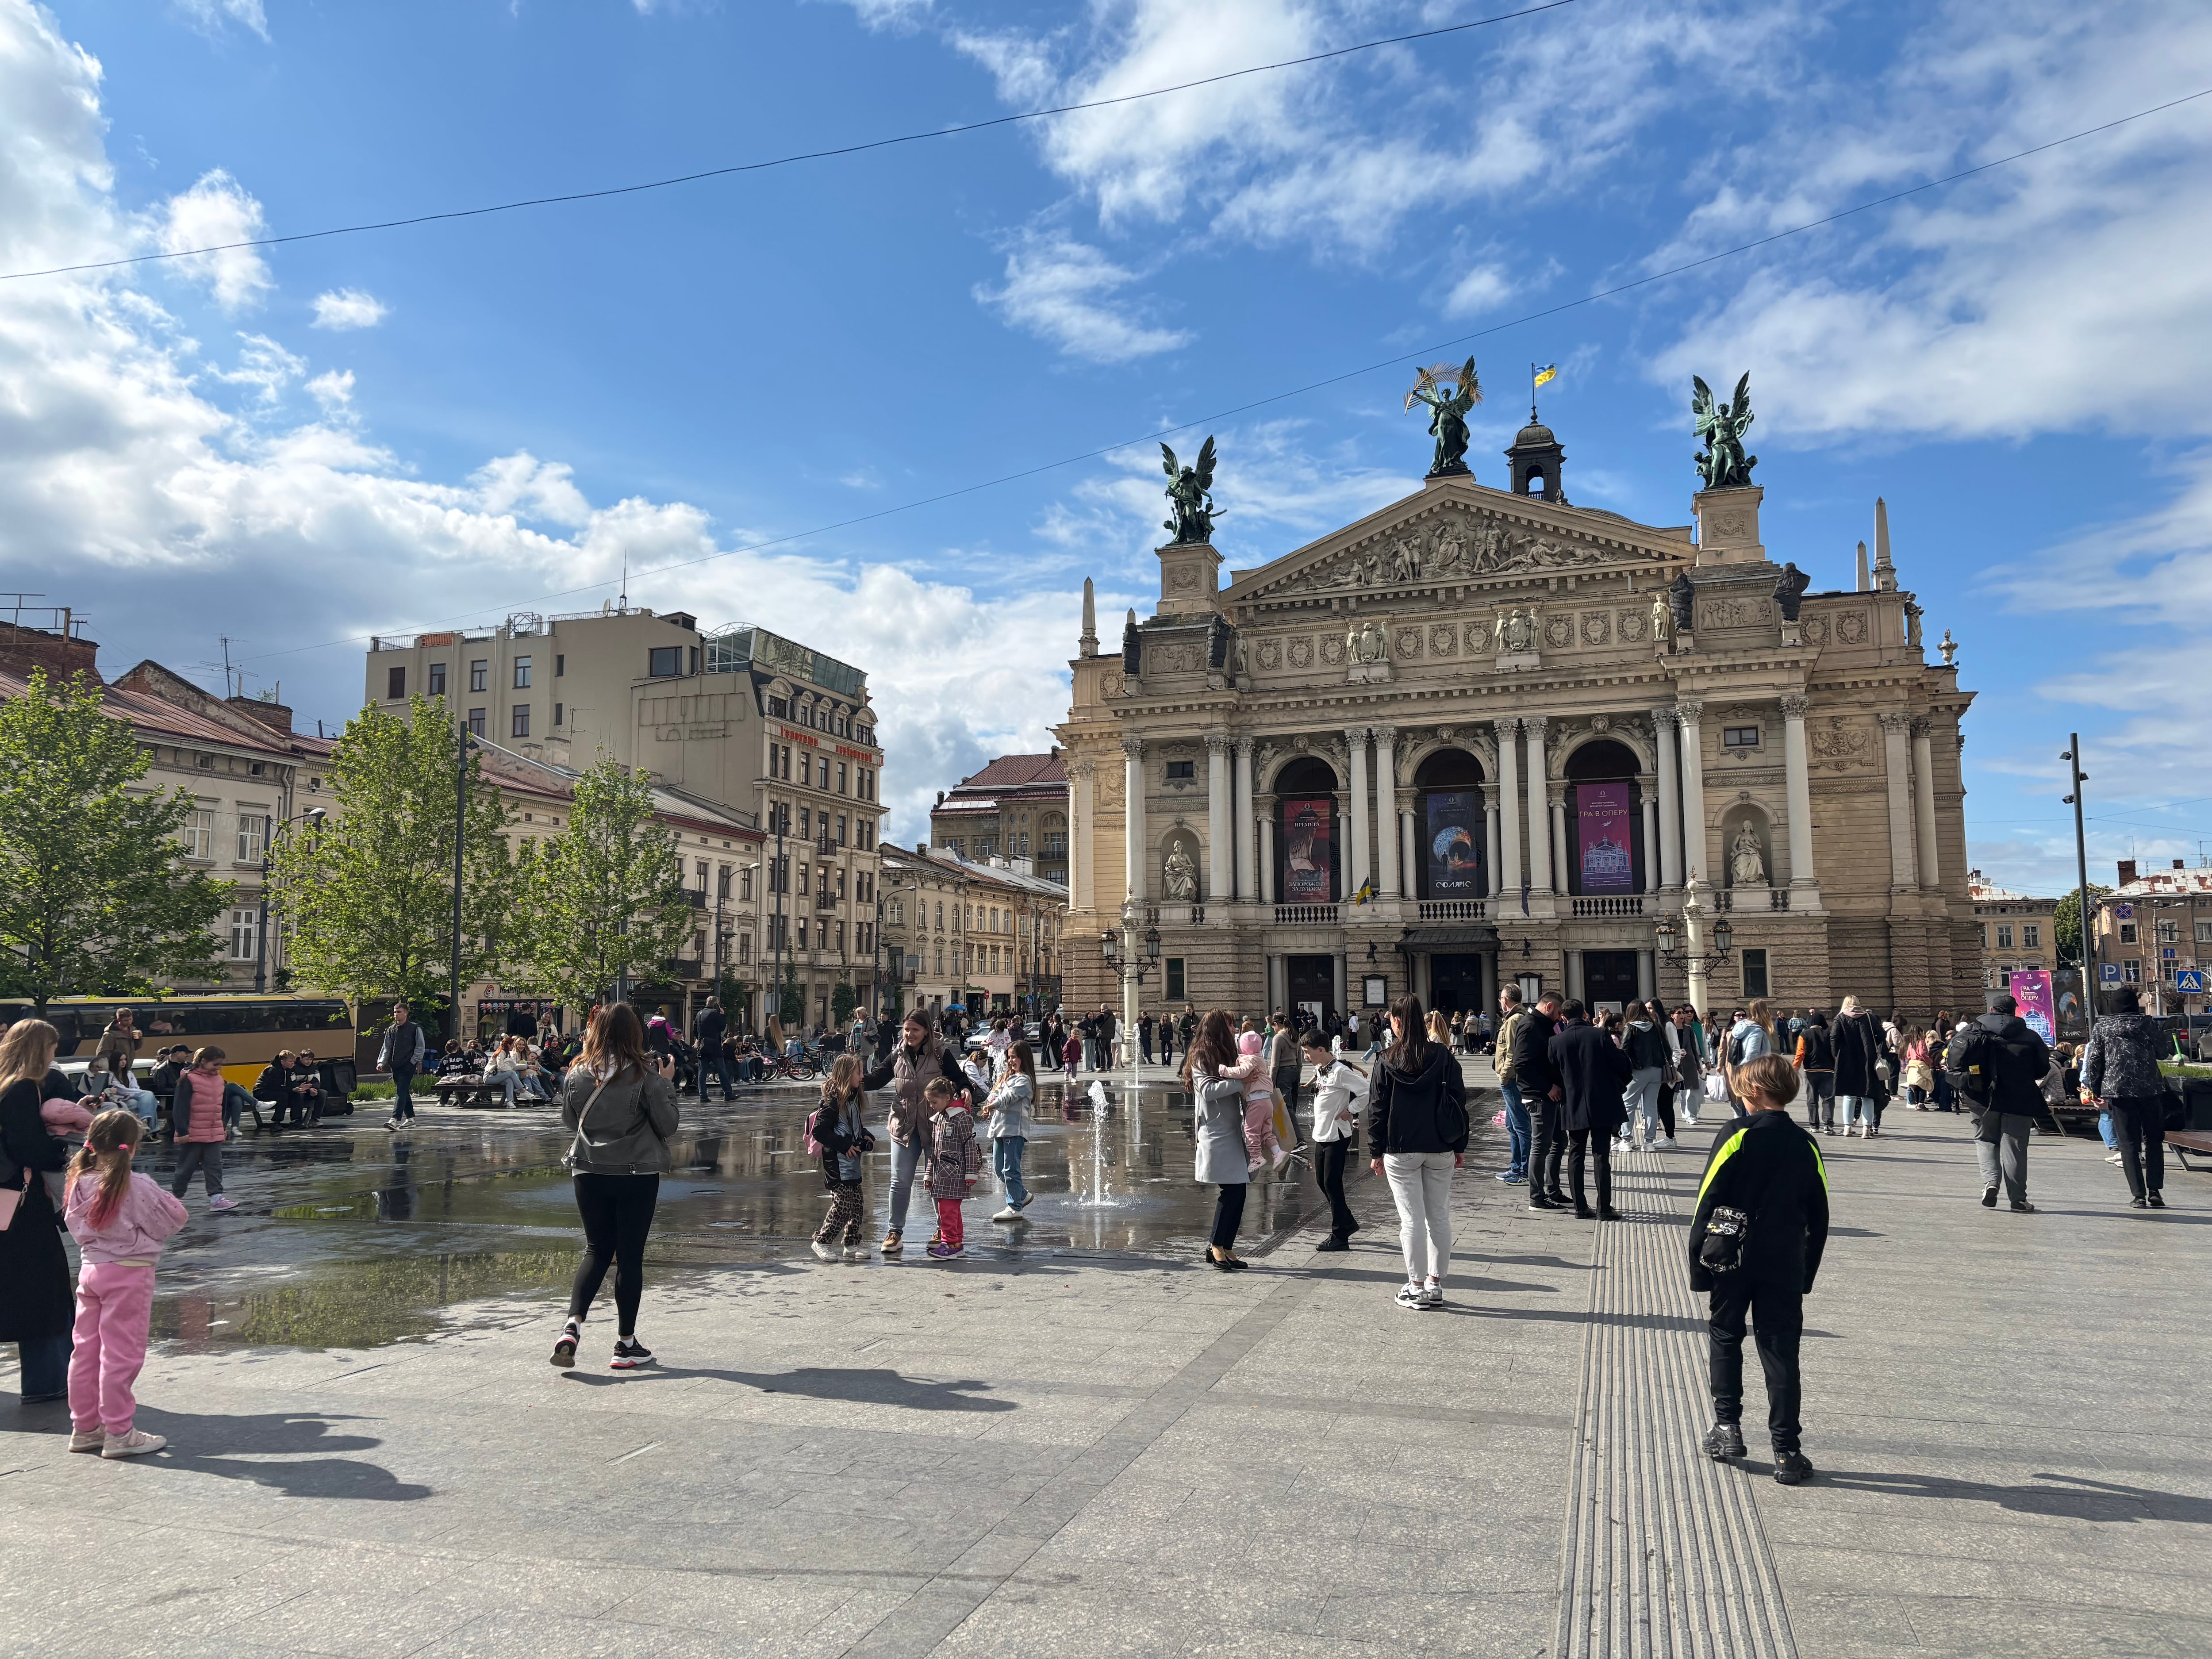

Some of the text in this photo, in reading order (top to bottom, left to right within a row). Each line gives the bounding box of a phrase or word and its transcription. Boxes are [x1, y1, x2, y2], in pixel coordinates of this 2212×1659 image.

[780, 726, 872, 762] Panorama restaurant
[2105, 965, 2116, 979] P
